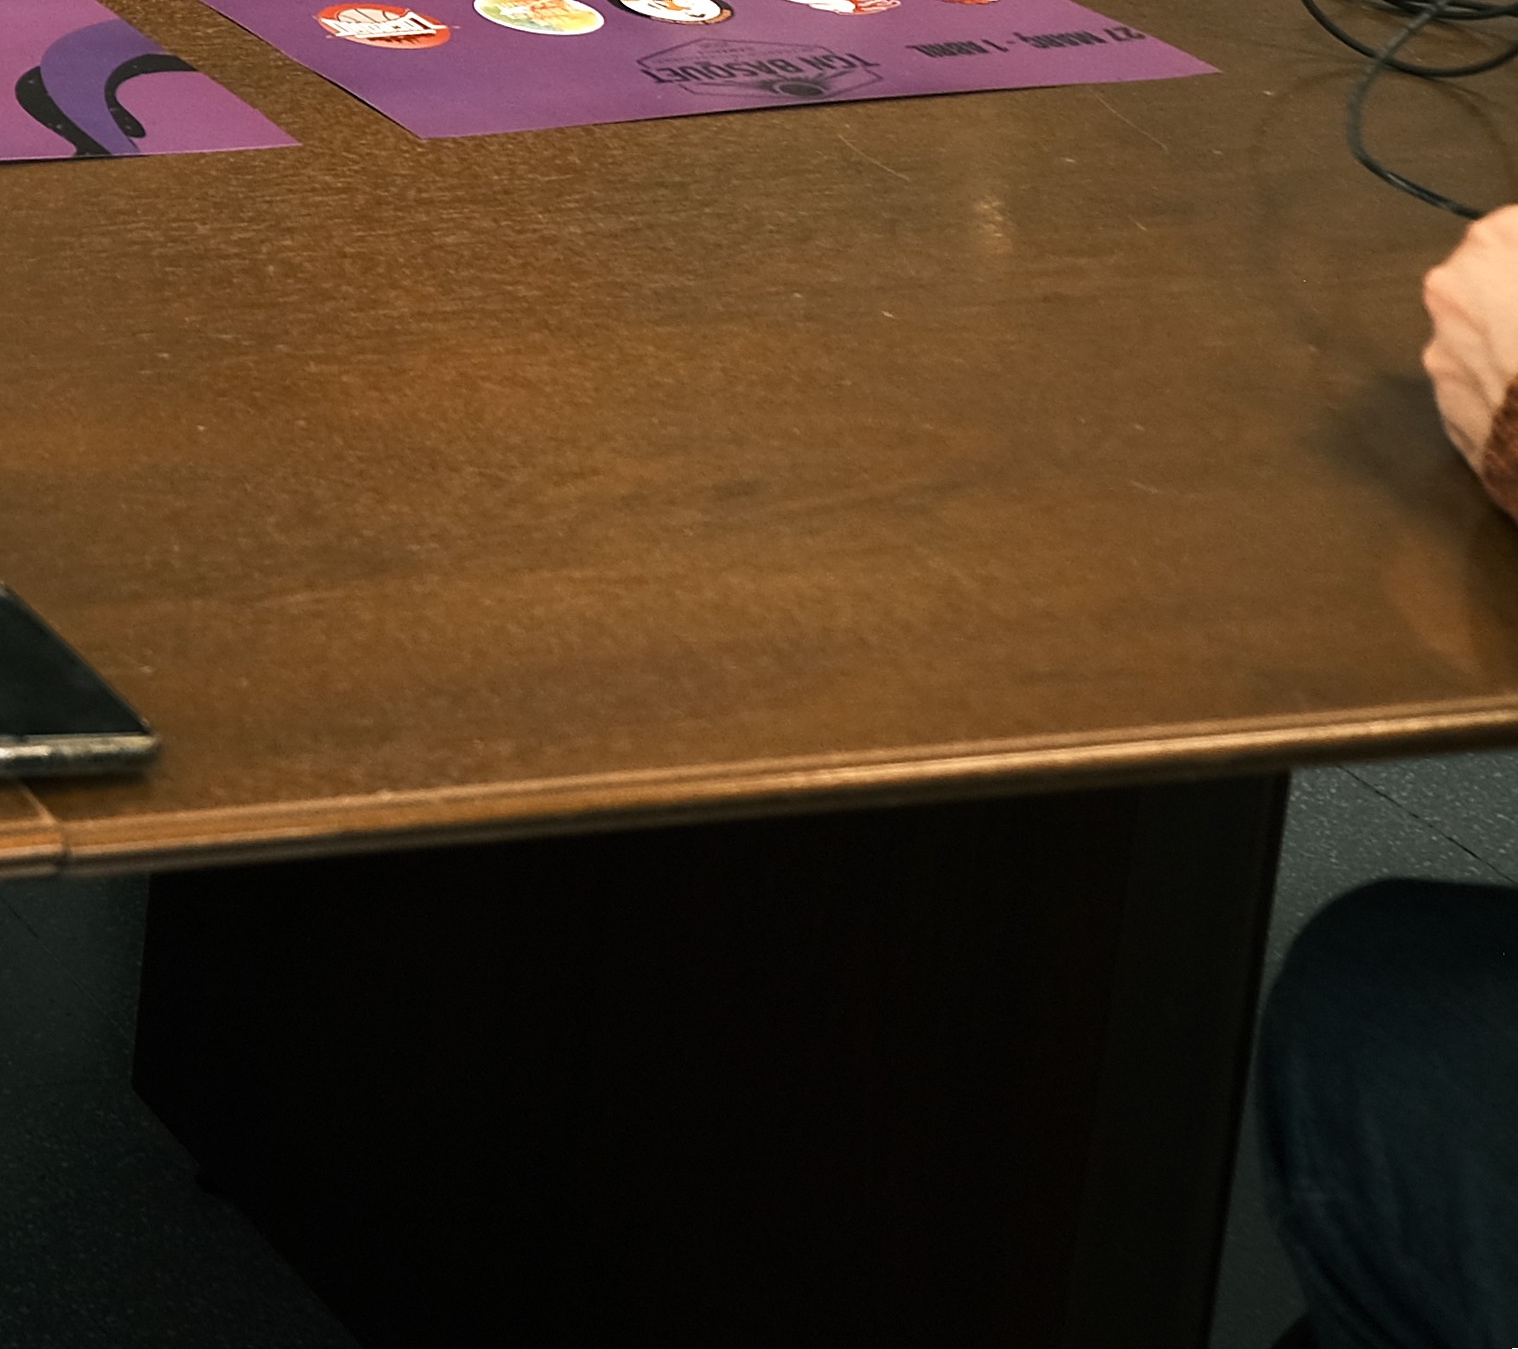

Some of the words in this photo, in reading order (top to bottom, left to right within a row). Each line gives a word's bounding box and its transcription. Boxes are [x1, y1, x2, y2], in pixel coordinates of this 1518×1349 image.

[982, 36, 1003, 54] 1
[1022, 29, 1103, 51] MARÇ
[1108, 24, 1142, 45] 27
[907, 40, 983, 60] ABRIL
[800, 51, 882, 72] TGN
